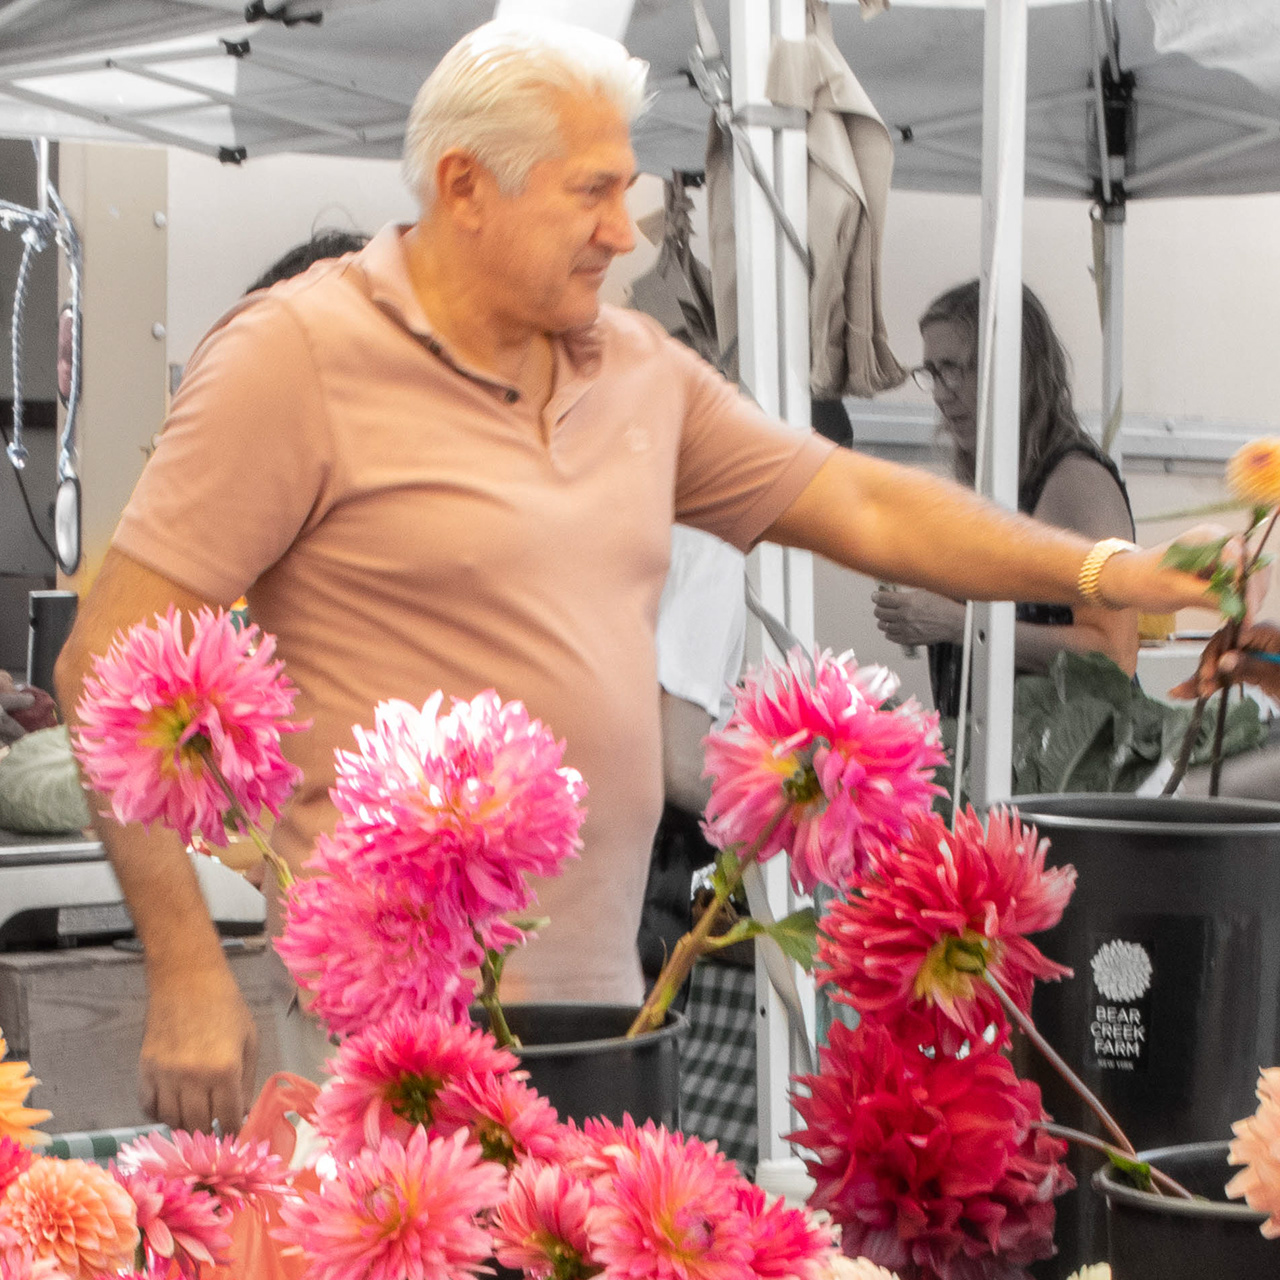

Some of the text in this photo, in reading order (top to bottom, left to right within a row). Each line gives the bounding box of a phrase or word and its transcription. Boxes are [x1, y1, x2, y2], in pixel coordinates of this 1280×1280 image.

[1096, 1005, 1141, 1025] BEAR
[1090, 1020, 1146, 1042] CREEK
[1094, 1038, 1140, 1058] FARM
